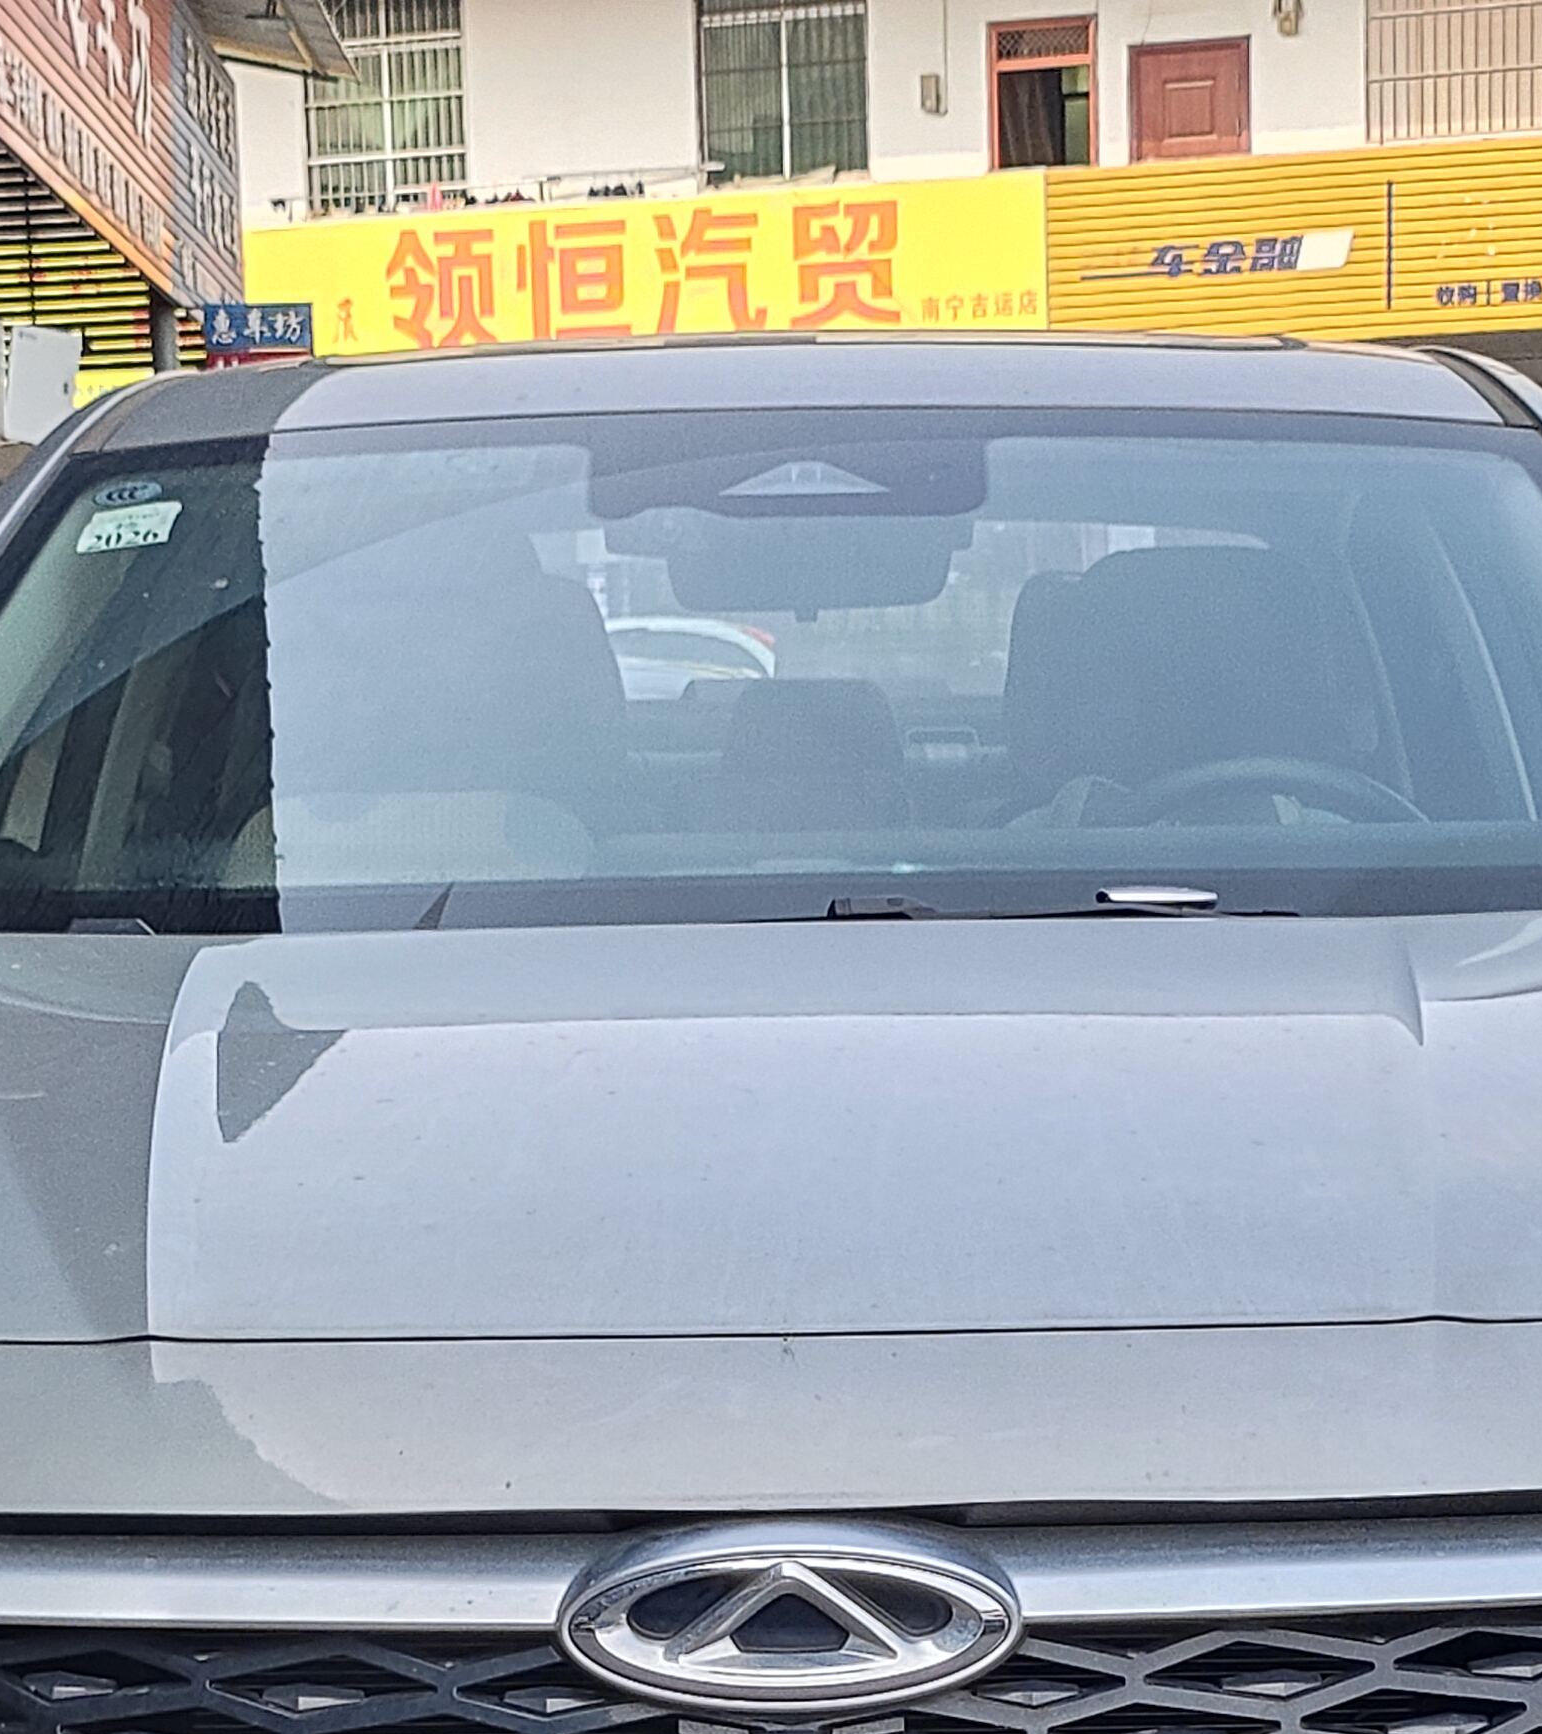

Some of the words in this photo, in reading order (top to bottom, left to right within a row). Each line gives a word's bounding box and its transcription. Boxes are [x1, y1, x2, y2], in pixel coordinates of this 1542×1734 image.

[385, 199, 901, 350] 领恒汽贸
[86, 528, 159, 552] 2026
